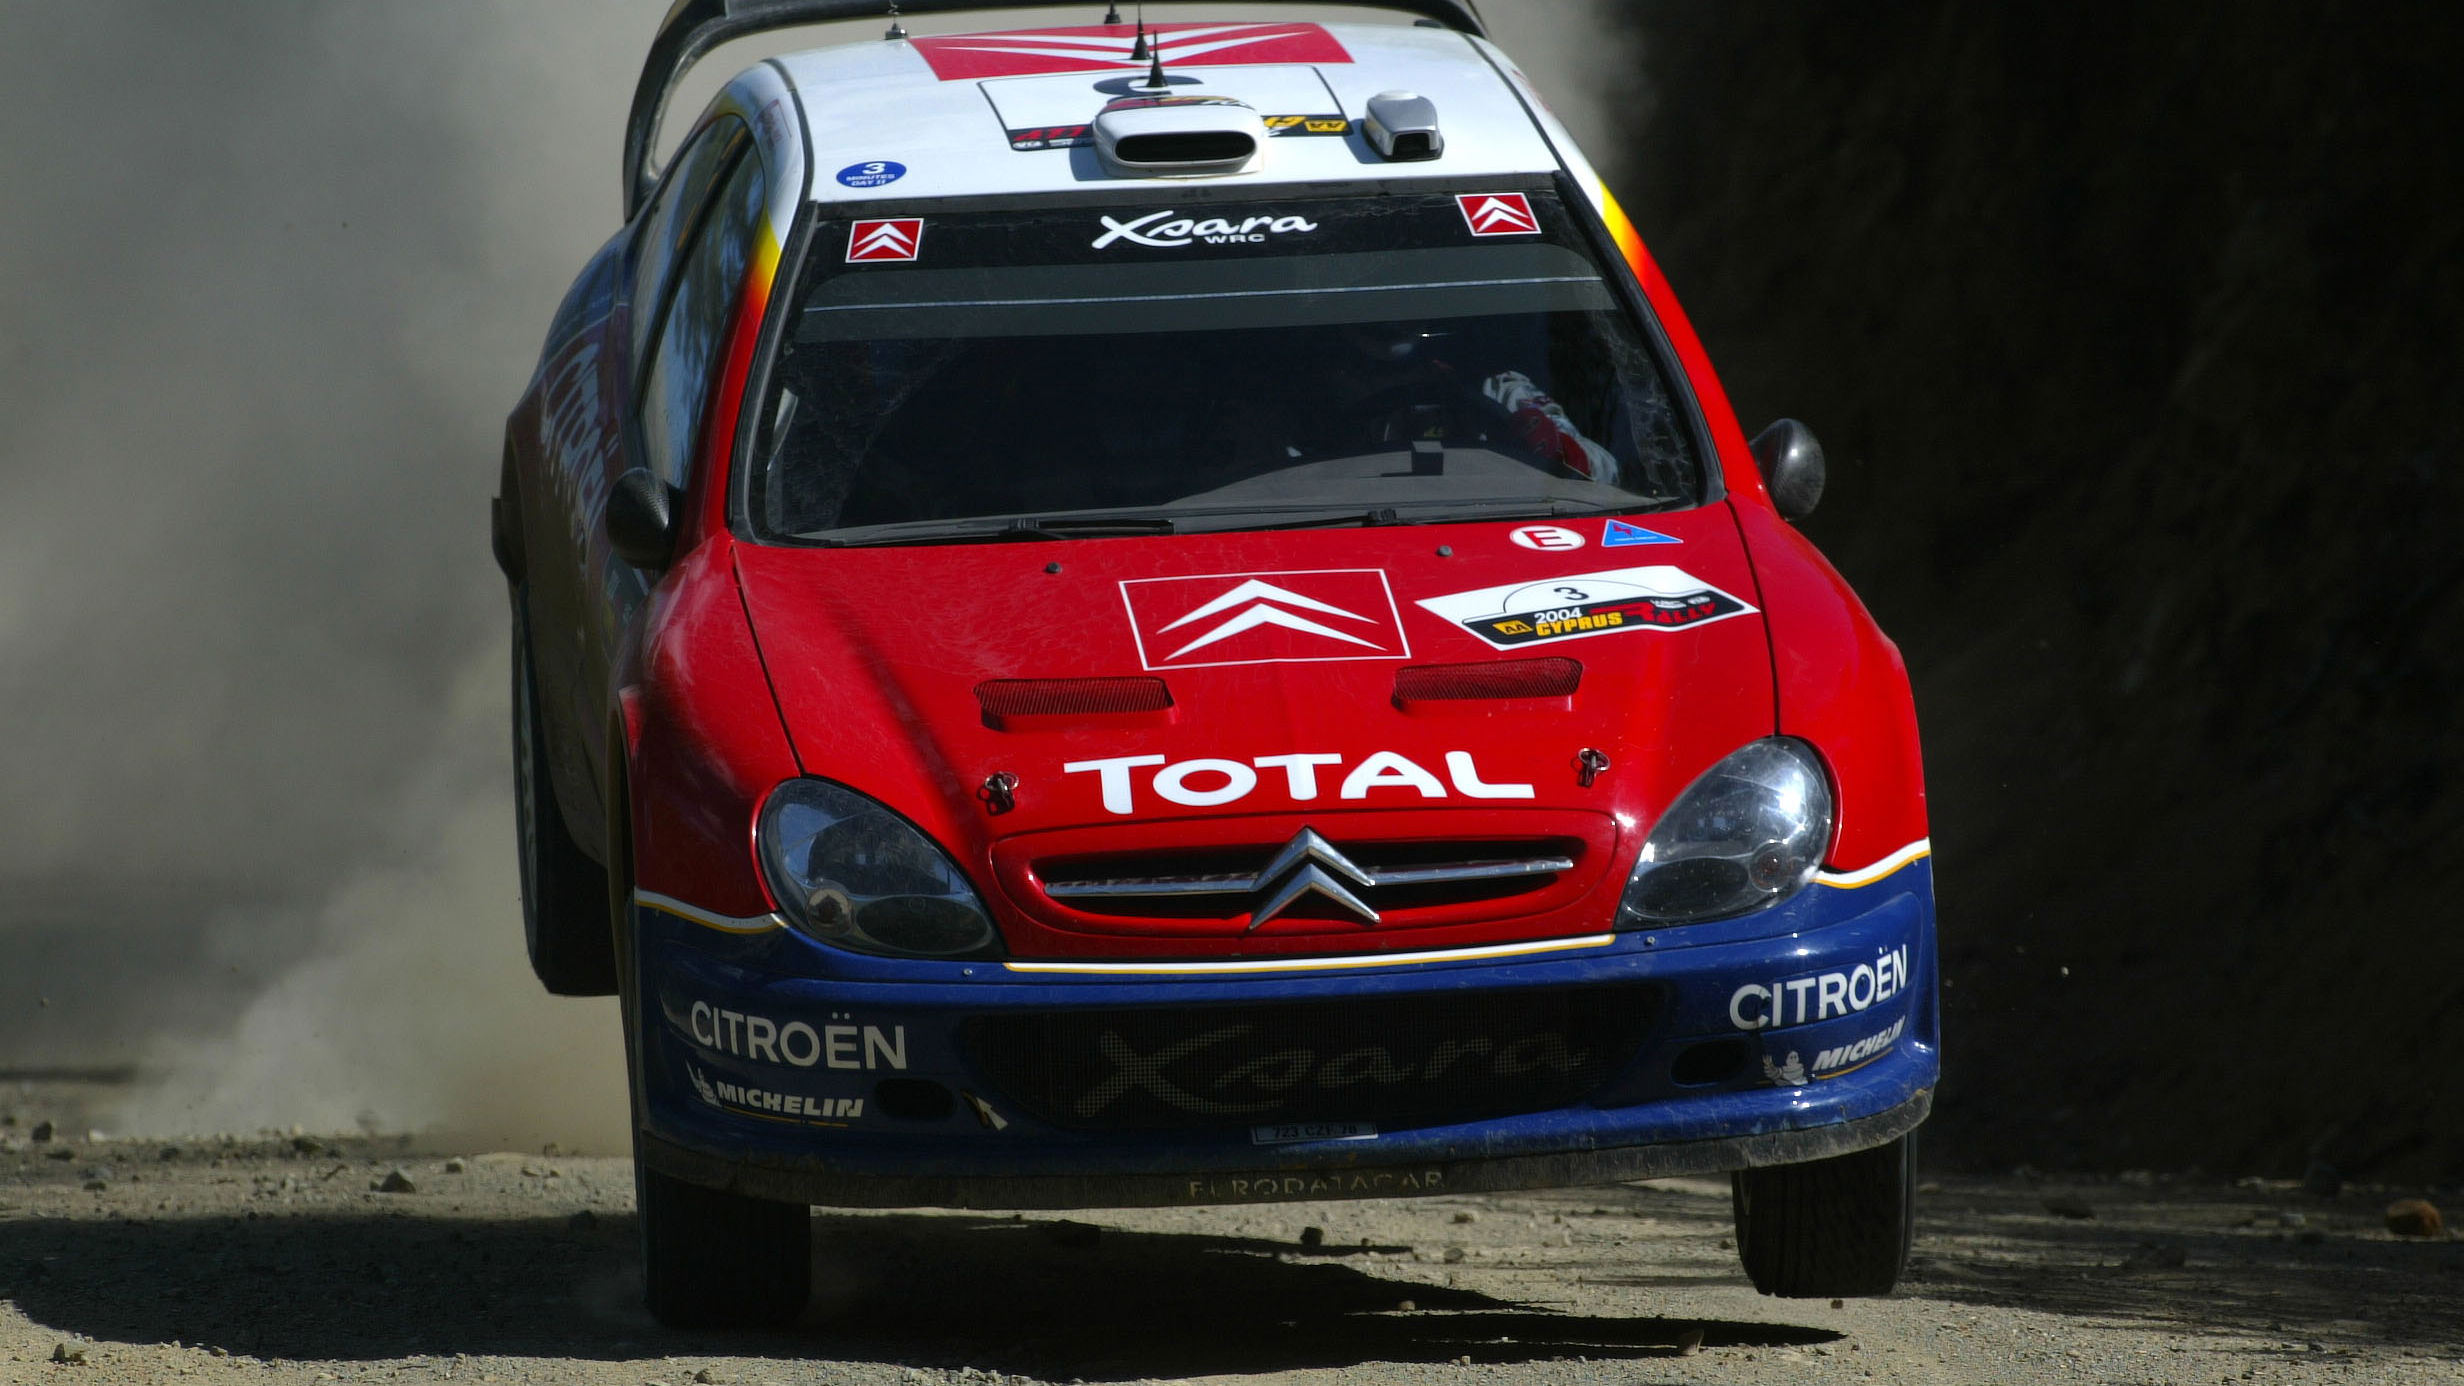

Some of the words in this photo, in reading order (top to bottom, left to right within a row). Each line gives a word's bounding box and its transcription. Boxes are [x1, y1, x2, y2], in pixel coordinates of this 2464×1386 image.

[862, 162, 886, 174] 3
[1092, 210, 1318, 249] Xsara
[1204, 232, 1266, 244] WRC
[1521, 529, 1574, 548] E
[1553, 587, 1589, 600] 3
[1534, 607, 1582, 624] 2004
[1535, 612, 1623, 636] CYPRUS
[1063, 751, 1535, 814] TOTAL
[1729, 944, 1907, 1031] CITROËN
[691, 1001, 907, 1070] CITROËN
[1812, 1015, 1905, 1071] MICHELIN
[1072, 1024, 1592, 1118] Xsara
[716, 1081, 864, 1117] MICHELIN
